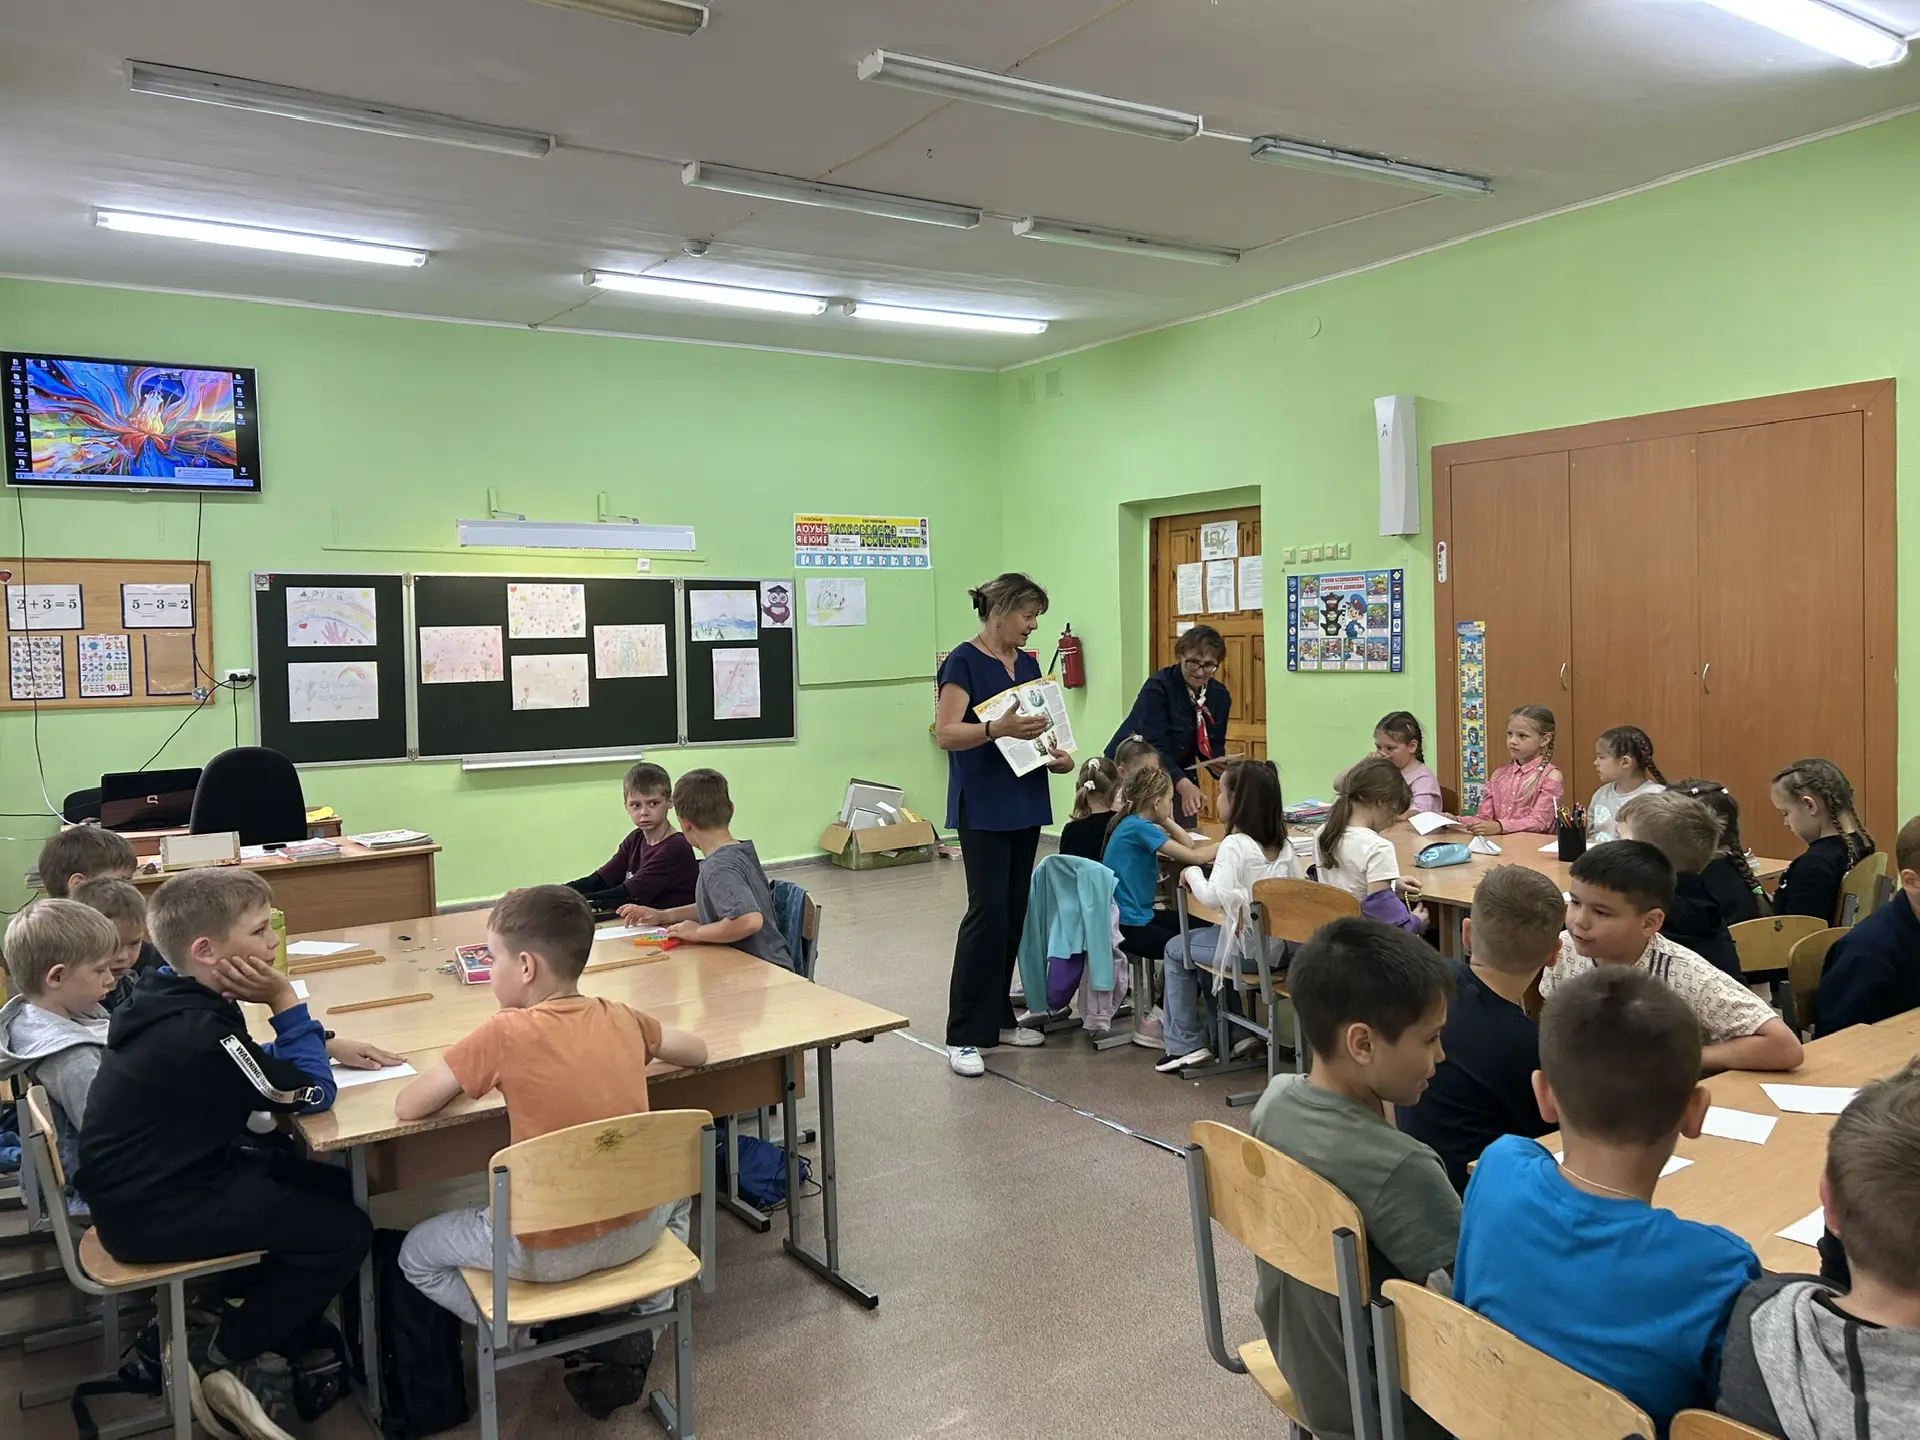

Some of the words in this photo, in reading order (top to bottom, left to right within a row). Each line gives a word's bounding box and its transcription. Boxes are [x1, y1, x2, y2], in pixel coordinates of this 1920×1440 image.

[17, 598, 25, 609] 2
[43, 598, 52, 609] 3
[69, 598, 77, 609] 5
[132, 598, 140, 609] 5
[157, 599, 165, 609] 3
[181, 599, 189, 609] 2
[105, 642, 112, 650] 2
[106, 652, 112, 660] 4
[82, 663, 88, 672] 5
[106, 663, 112, 671] 6
[82, 674, 89, 682] 7
[106, 684, 116, 692] 10
[236, 1045, 262, 1079] WARNING
